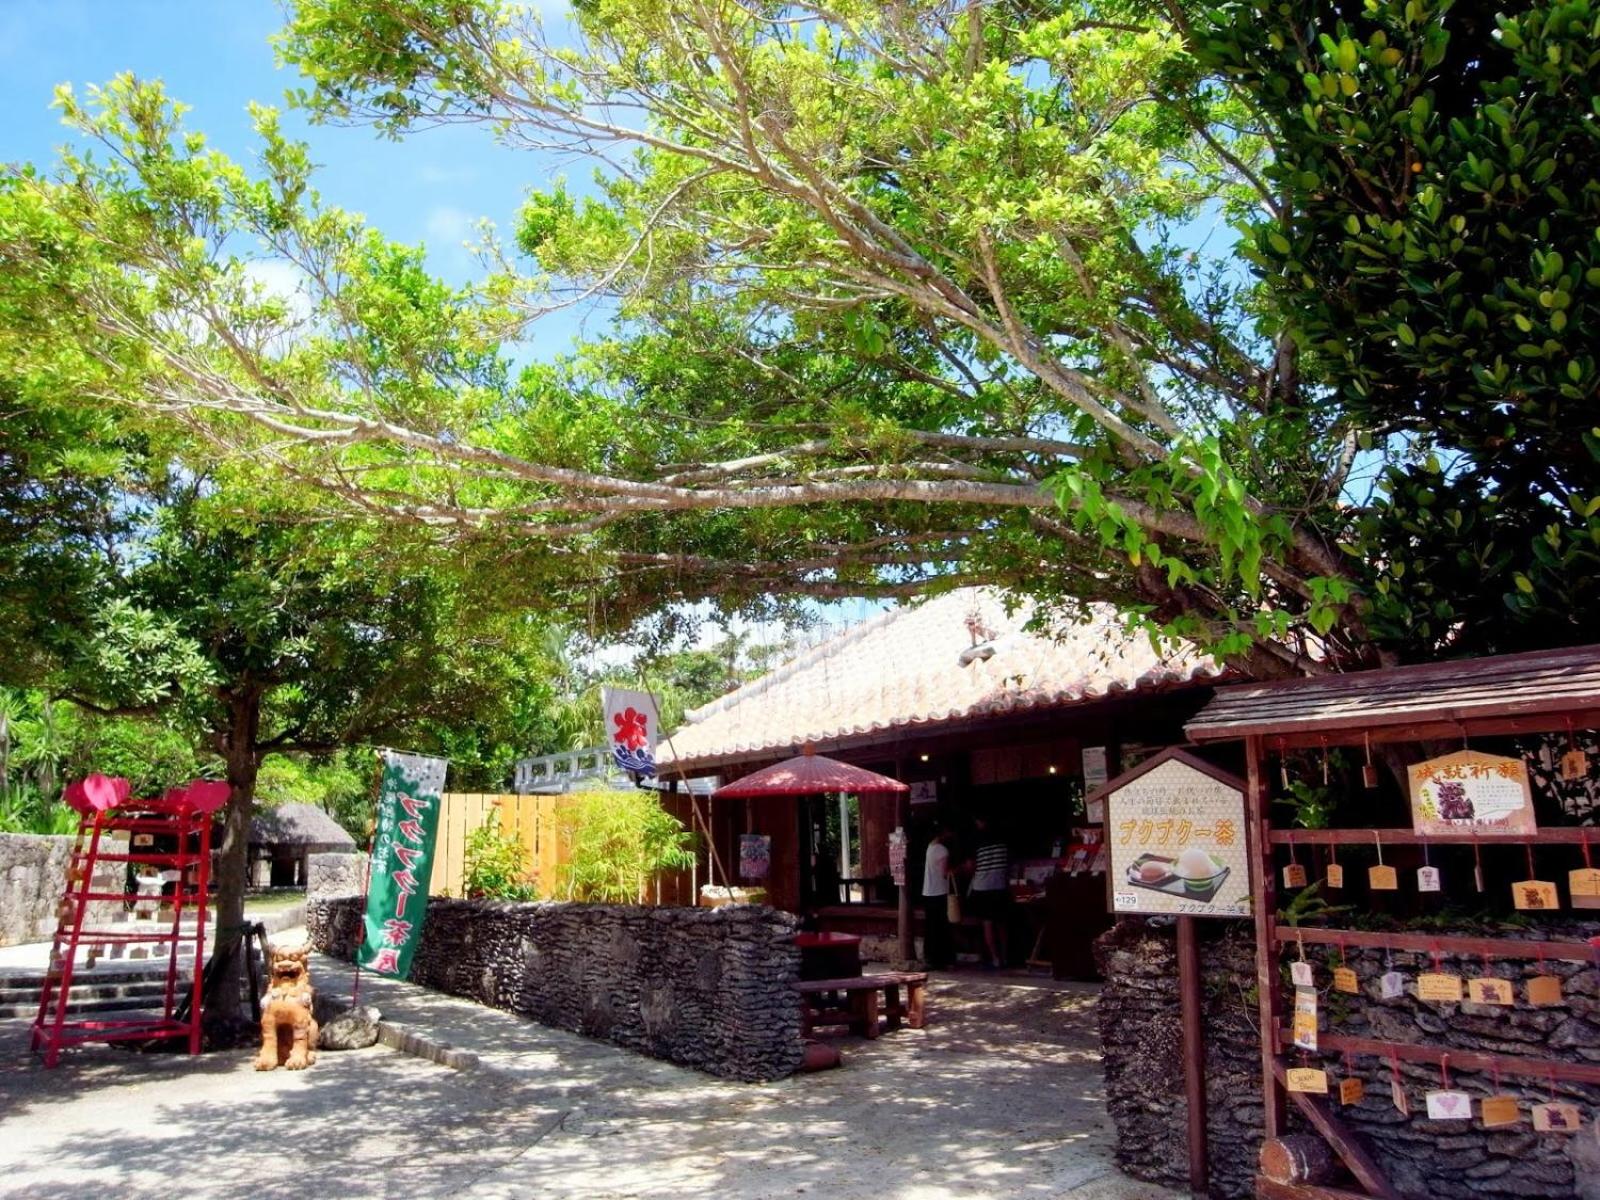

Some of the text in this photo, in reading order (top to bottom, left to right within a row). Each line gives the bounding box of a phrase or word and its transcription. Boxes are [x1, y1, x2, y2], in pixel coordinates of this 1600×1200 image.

[1119, 818, 1235, 846] ブクブクー茶
[1122, 896, 1136, 905] 129
